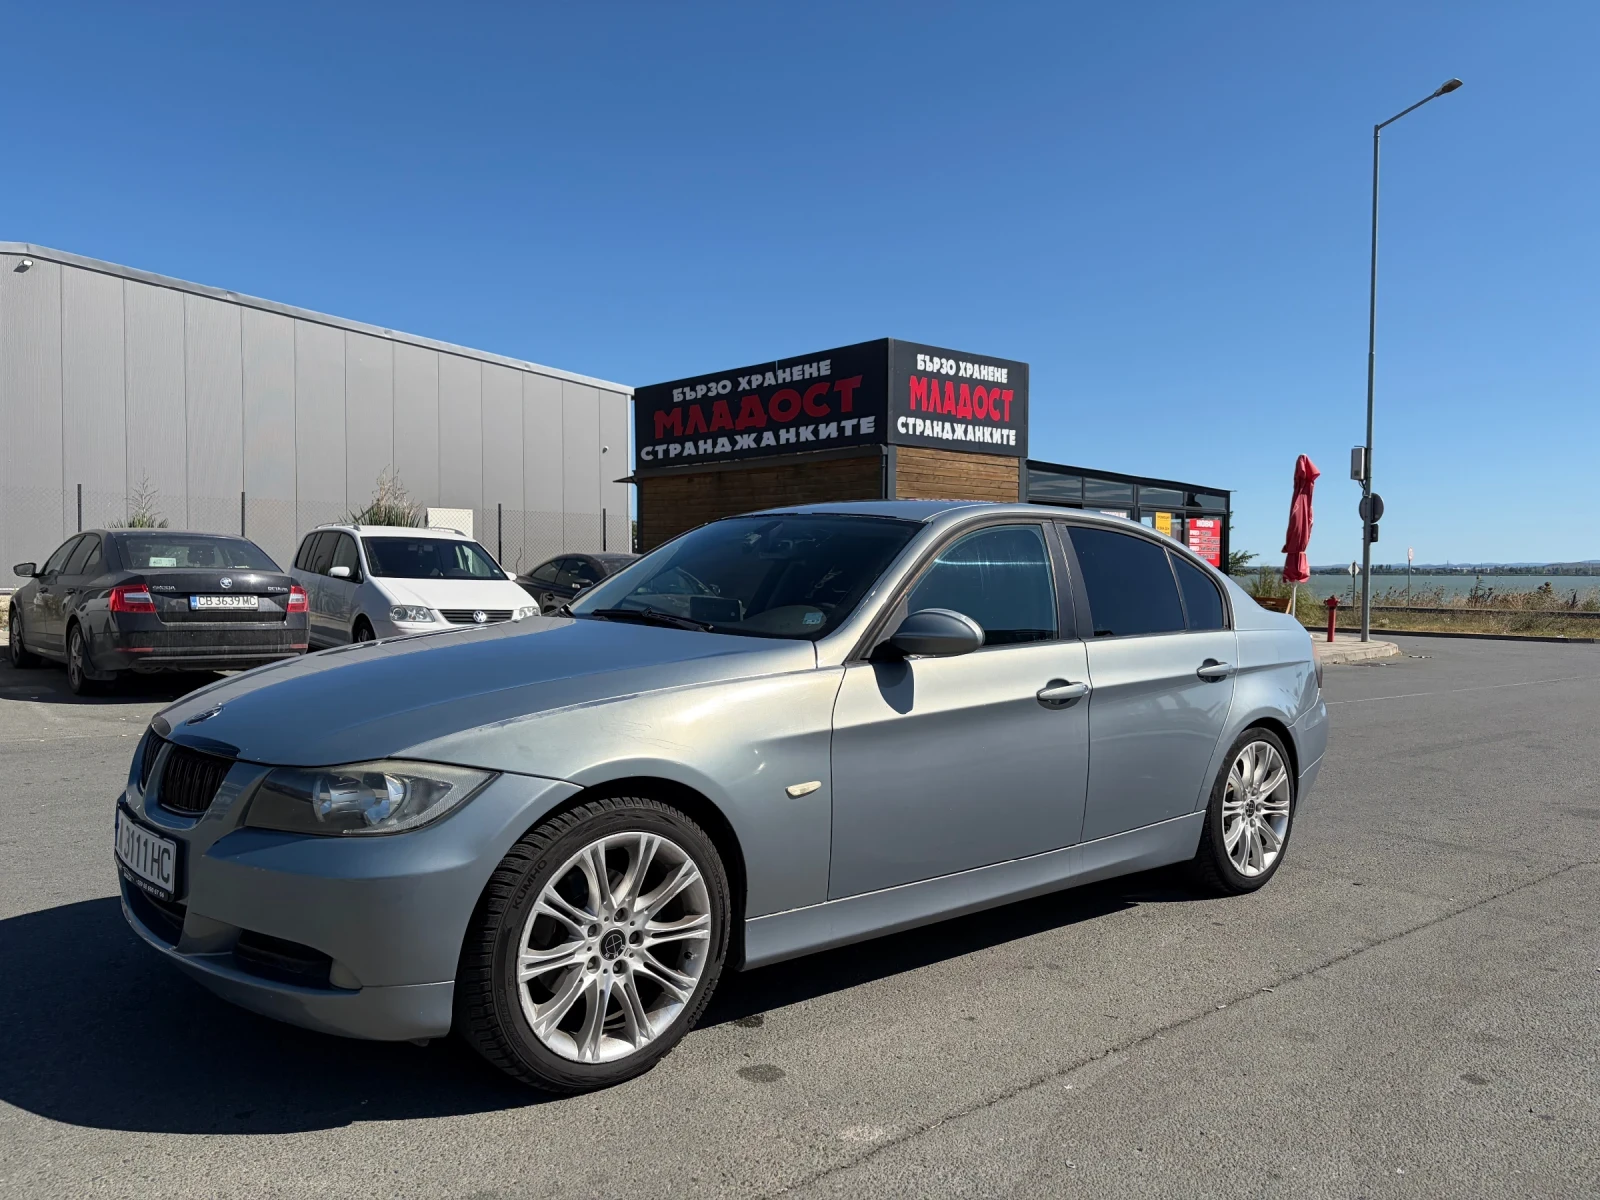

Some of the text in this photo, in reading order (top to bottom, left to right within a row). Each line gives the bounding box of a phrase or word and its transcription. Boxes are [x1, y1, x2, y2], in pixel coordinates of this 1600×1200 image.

[673, 359, 832, 402] БЪРЗО ХРАНЕНЕ
[916, 353, 1008, 384] БЪРЗО ХРАНЕНЕ
[654, 375, 863, 440] МЛАДОСТ
[909, 375, 1014, 422] МЛАДОСТ
[640, 415, 876, 462] СТРАНДЖАНКИТЕ
[897, 415, 1017, 447] СТРАНДЖАНКИТЕ
[198, 596, 213, 606] CB
[214, 596, 240, 606] 3639
[242, 596, 257, 606] MC
[512, 860, 547, 910] KUMHO
